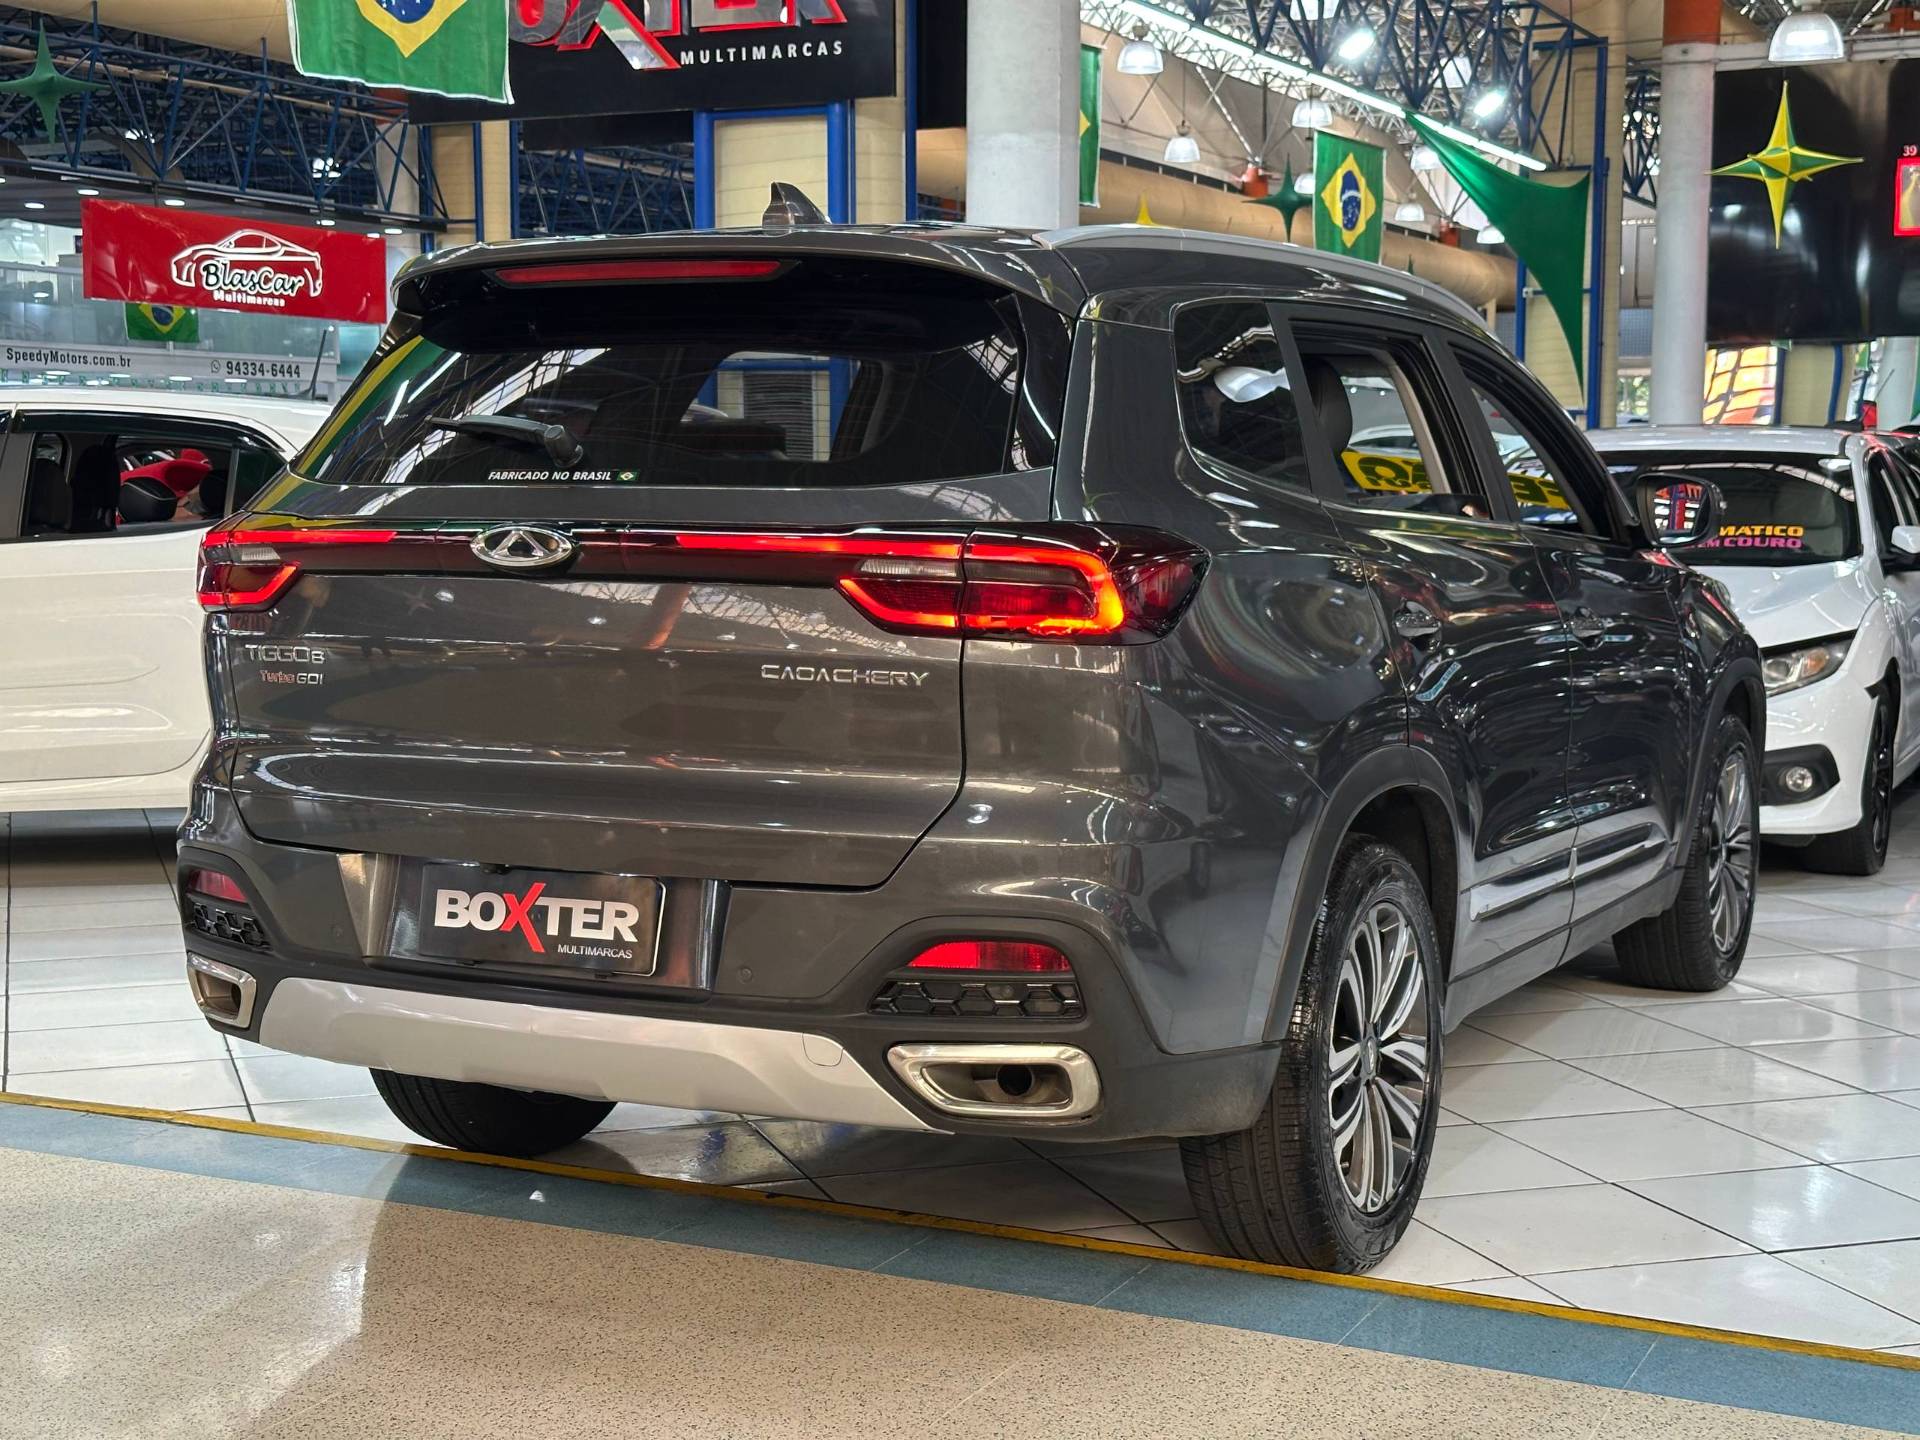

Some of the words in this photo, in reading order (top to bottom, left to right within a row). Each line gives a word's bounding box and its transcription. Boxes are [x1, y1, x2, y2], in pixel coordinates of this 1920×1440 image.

[680, 40, 844, 66] MULTIMARCAS
[201, 260, 304, 296] BlasCar
[213, 289, 286, 307] Multimarcas
[6, 347, 132, 369] SpeedyMotors.com.br
[225, 360, 301, 378] 94334-6444
[487, 471, 549, 481] FABRICADO
[551, 471, 570, 481] NO
[572, 471, 612, 481] BRASIL
[1723, 536, 1803, 548] COURO
[434, 882, 640, 953] BOXTER
[557, 943, 633, 959] MULTIMARCAS
